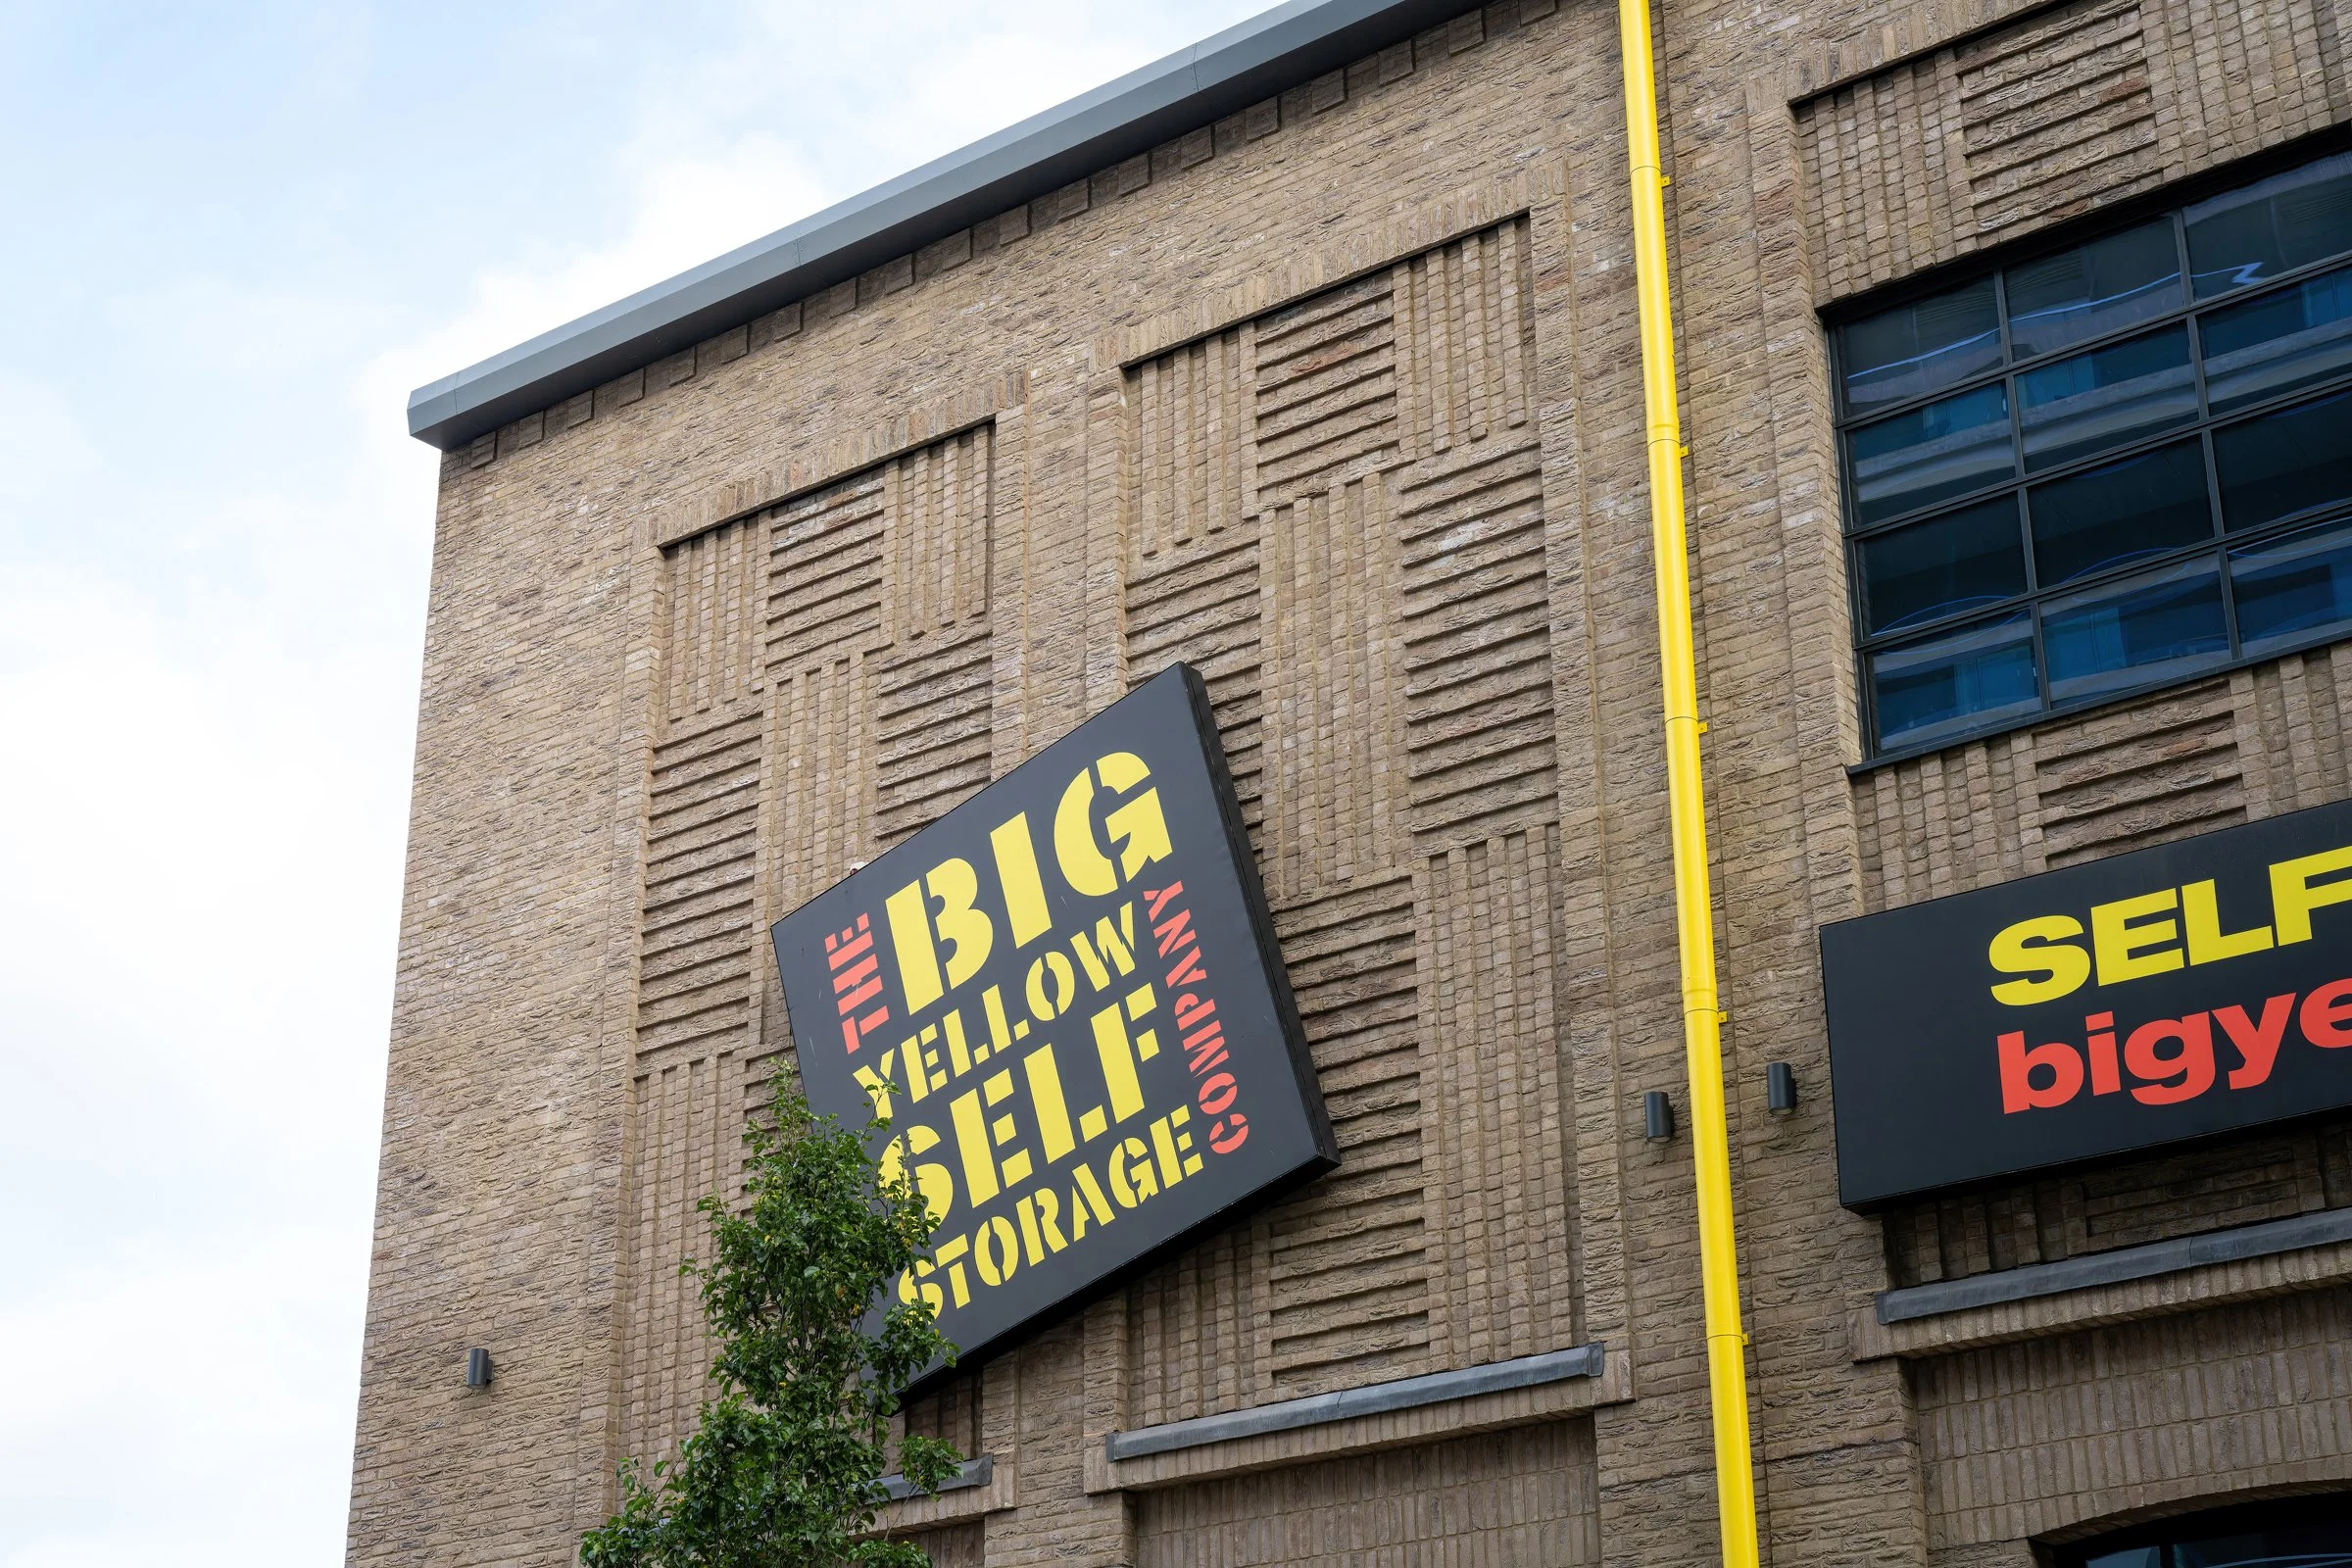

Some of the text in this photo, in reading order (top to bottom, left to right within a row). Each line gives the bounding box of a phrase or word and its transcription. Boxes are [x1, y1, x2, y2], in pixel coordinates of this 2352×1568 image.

[824, 912, 889, 1055] THE
[885, 752, 1173, 1016] BIG
[1988, 845, 2352, 1006] SELF
[853, 901, 1137, 1119] YELLOW
[878, 982, 1160, 1234] SELF
[1145, 881, 1250, 1154] COMPANY
[898, 1105, 1204, 1322] STORAGE
